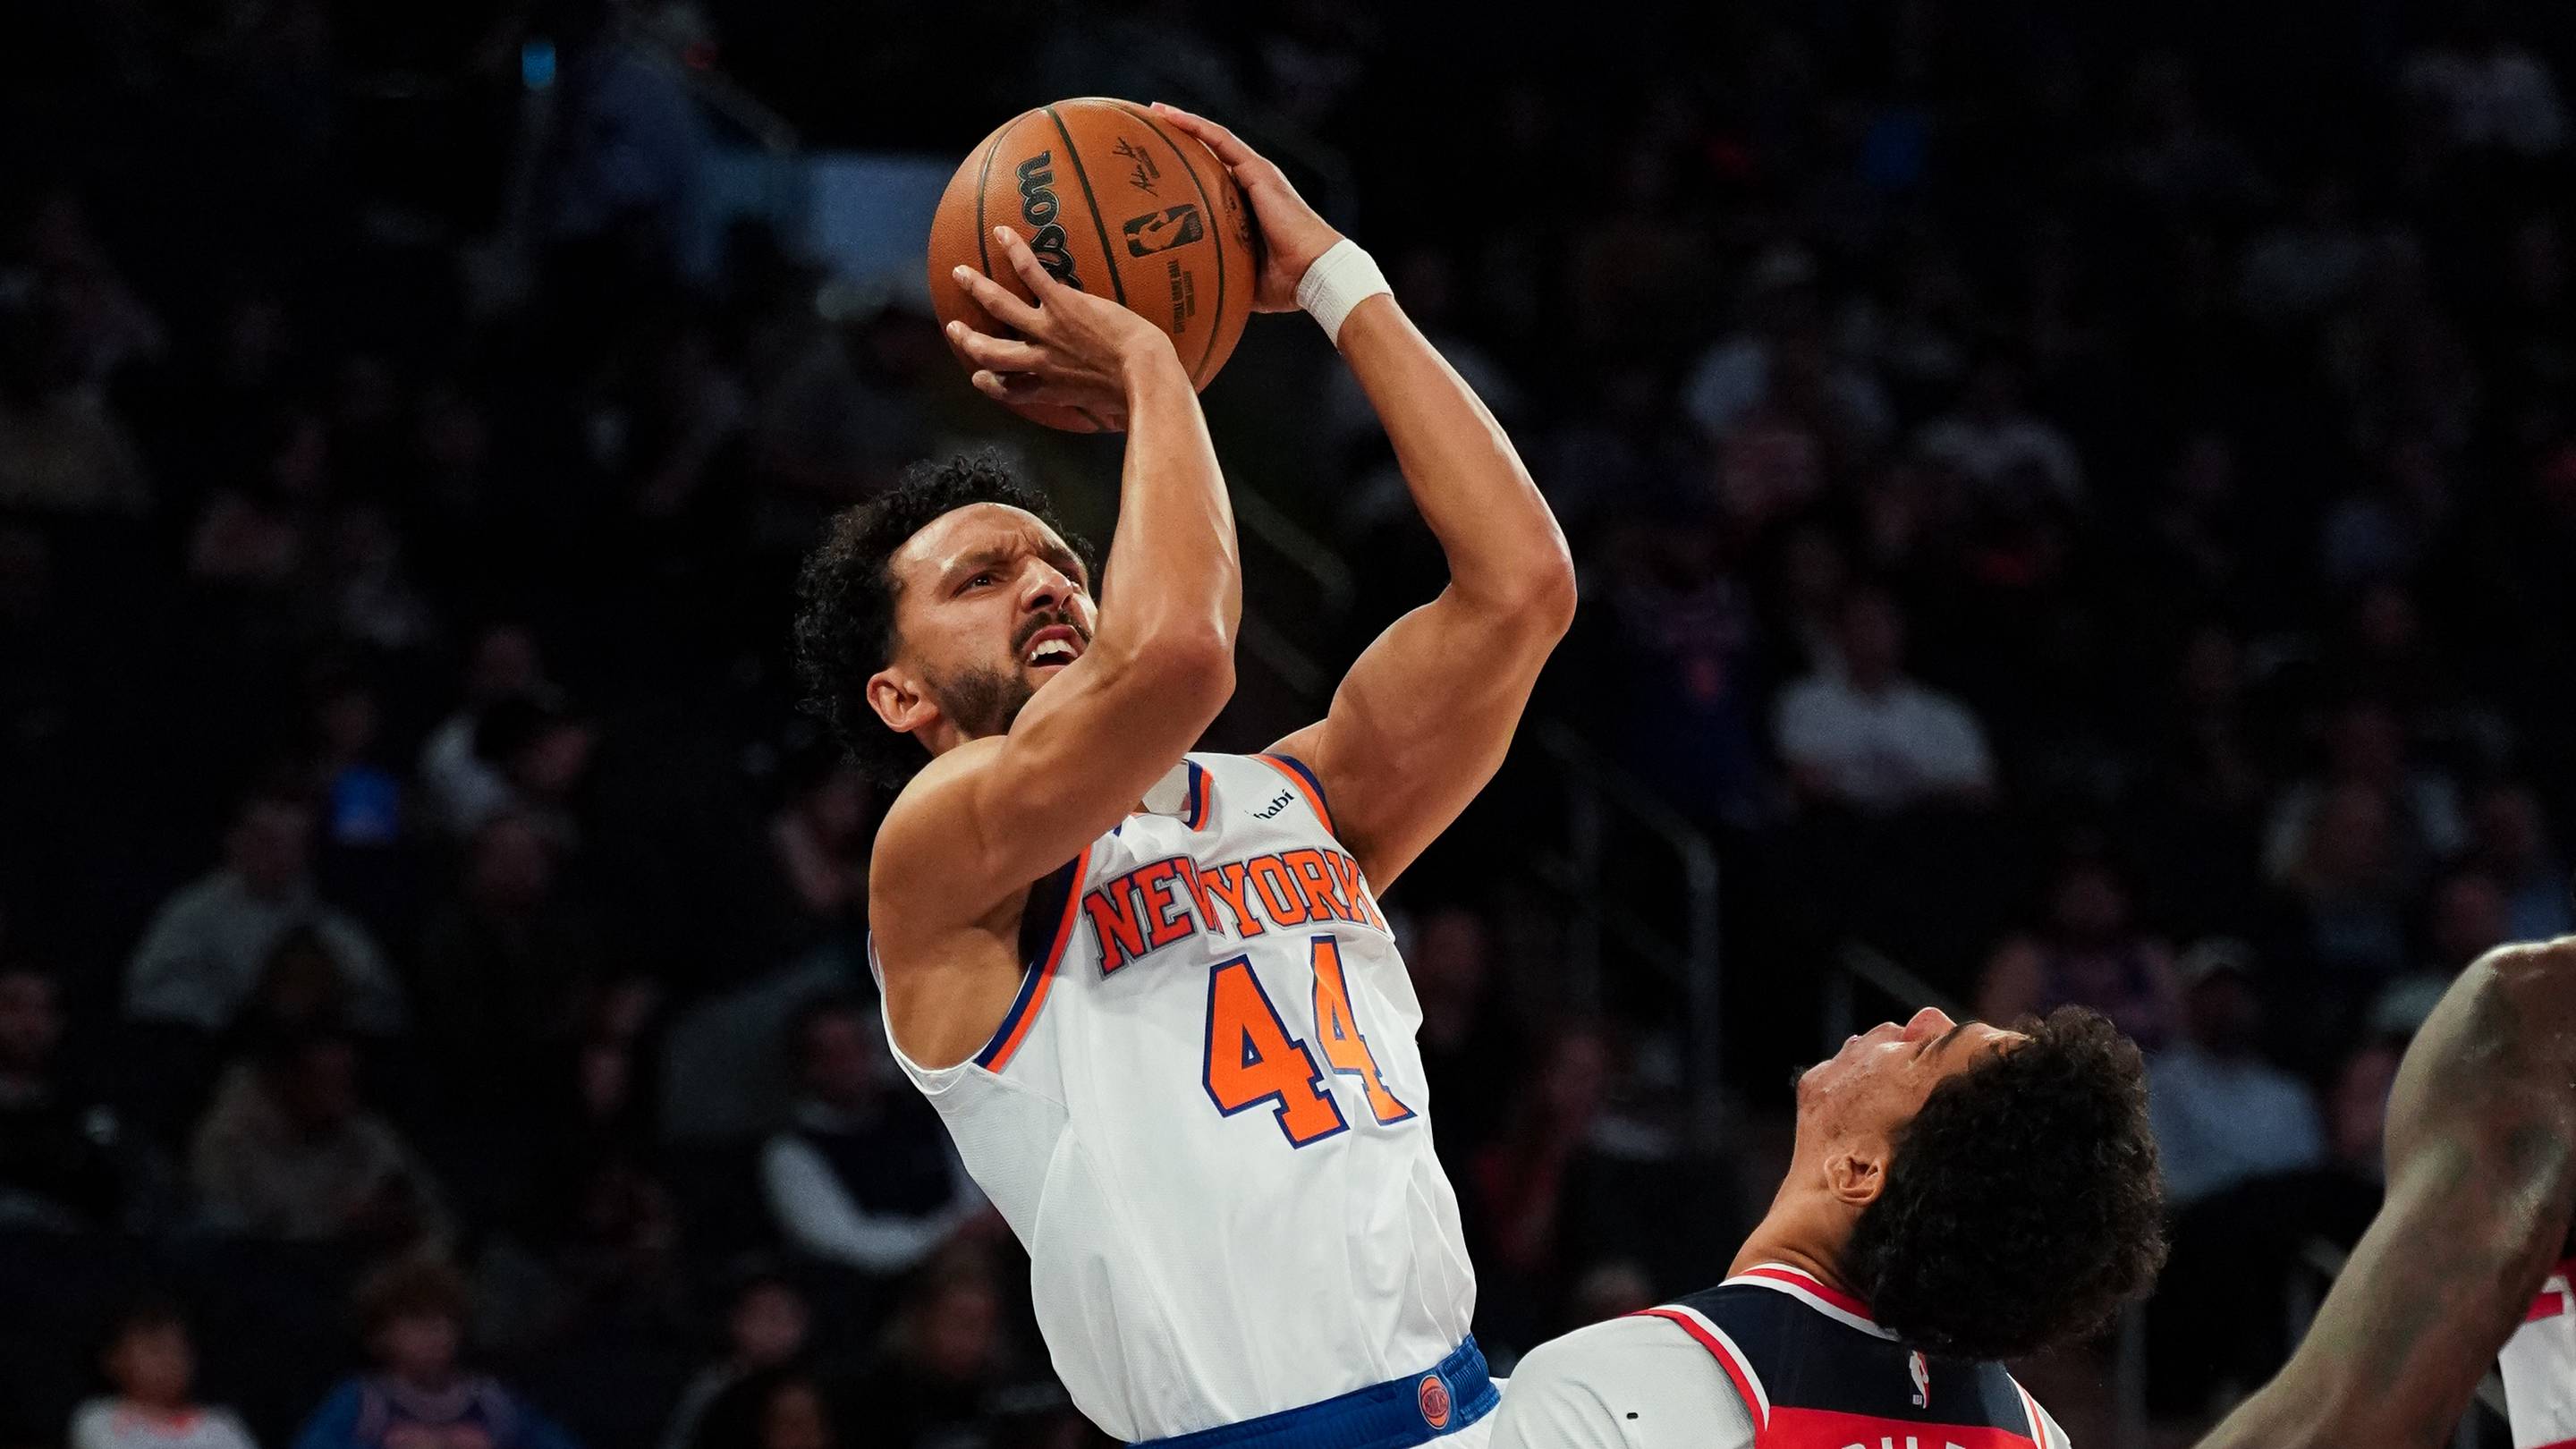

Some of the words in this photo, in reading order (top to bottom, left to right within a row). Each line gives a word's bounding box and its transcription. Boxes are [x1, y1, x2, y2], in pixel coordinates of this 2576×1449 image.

[1244, 788, 1295, 819] habi
[1199, 846, 1389, 939] YORK
[1202, 935, 1419, 1150] 44
